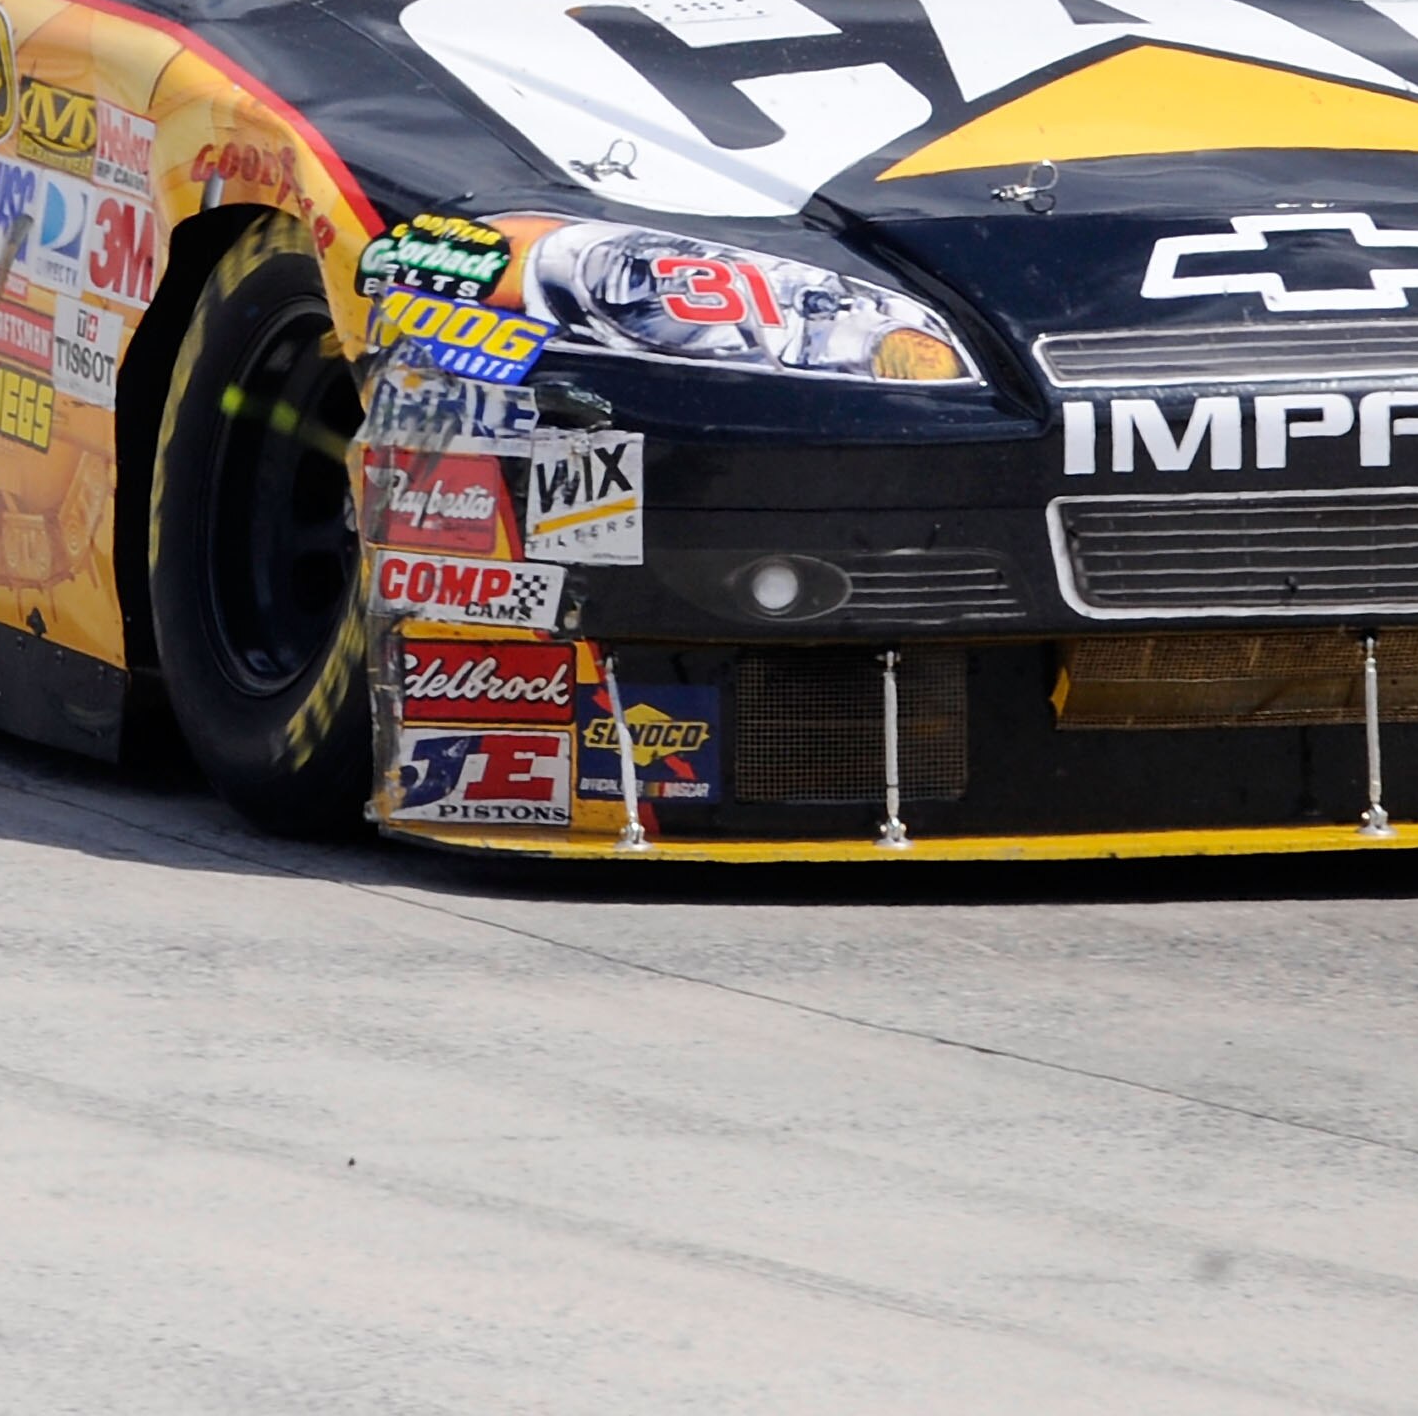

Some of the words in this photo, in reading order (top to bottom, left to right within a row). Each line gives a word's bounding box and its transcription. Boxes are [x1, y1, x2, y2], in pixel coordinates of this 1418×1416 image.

[90, 198, 157, 303] 3M
[650, 256, 787, 328] 31
[369, 292, 549, 362] MOOG
[55, 336, 115, 386] TISSOT
[440, 347, 516, 380] PARTS
[365, 464, 495, 528] Raybestos
[536, 443, 633, 514] WIX
[380, 557, 512, 607] COMP
[399, 734, 562, 810] JE
[437, 803, 571, 824] PISTONS
